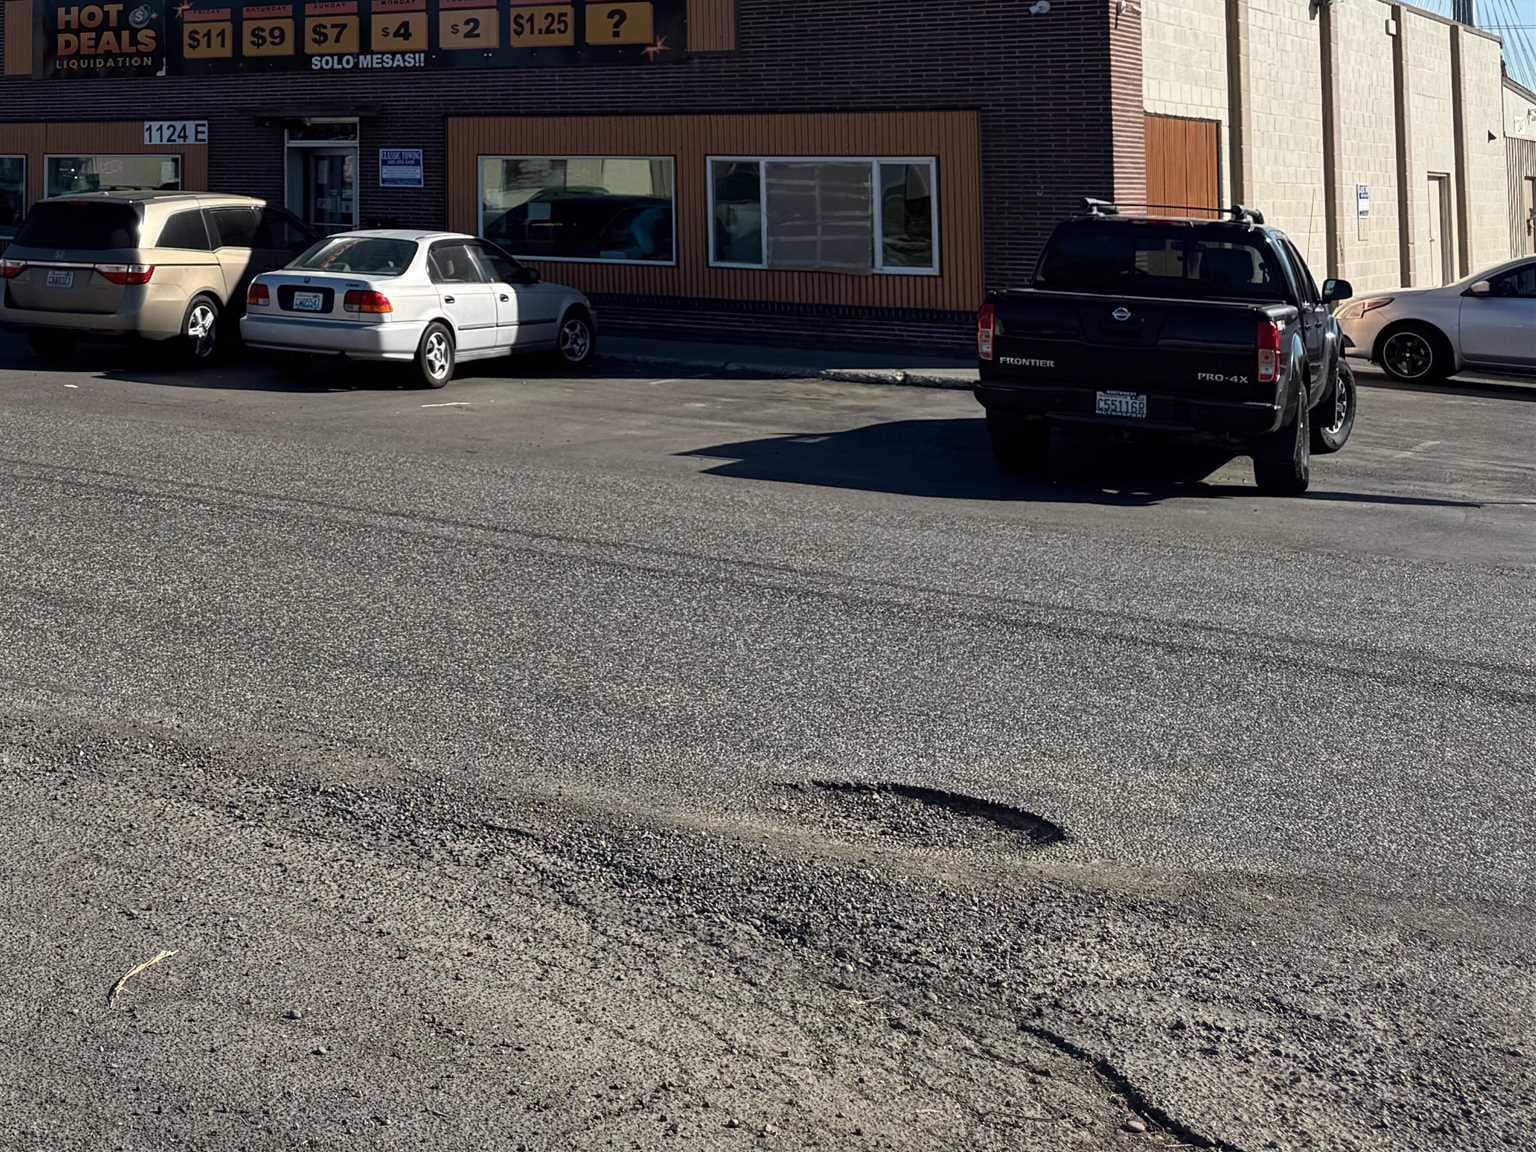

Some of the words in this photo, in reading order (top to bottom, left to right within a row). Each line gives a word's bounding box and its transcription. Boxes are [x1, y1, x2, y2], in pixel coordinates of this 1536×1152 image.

[57, 3, 124, 31] HOT
[513, 12, 569, 38] $1.25
[607, 8, 627, 38] ?
[55, 28, 158, 56] DEALS
[187, 28, 226, 50] $11
[250, 26, 285, 48] $9
[311, 22, 348, 46] $7
[55, 55, 153, 70] LIQUIDATION
[311, 55, 355, 70] SOLO
[358, 52, 425, 69] MESAS!!
[145, 123, 189, 143] 1124
[194, 123, 207, 143] E
[999, 356, 1056, 368] FRONTIER
[1197, 372, 1249, 384] PRO-4X
